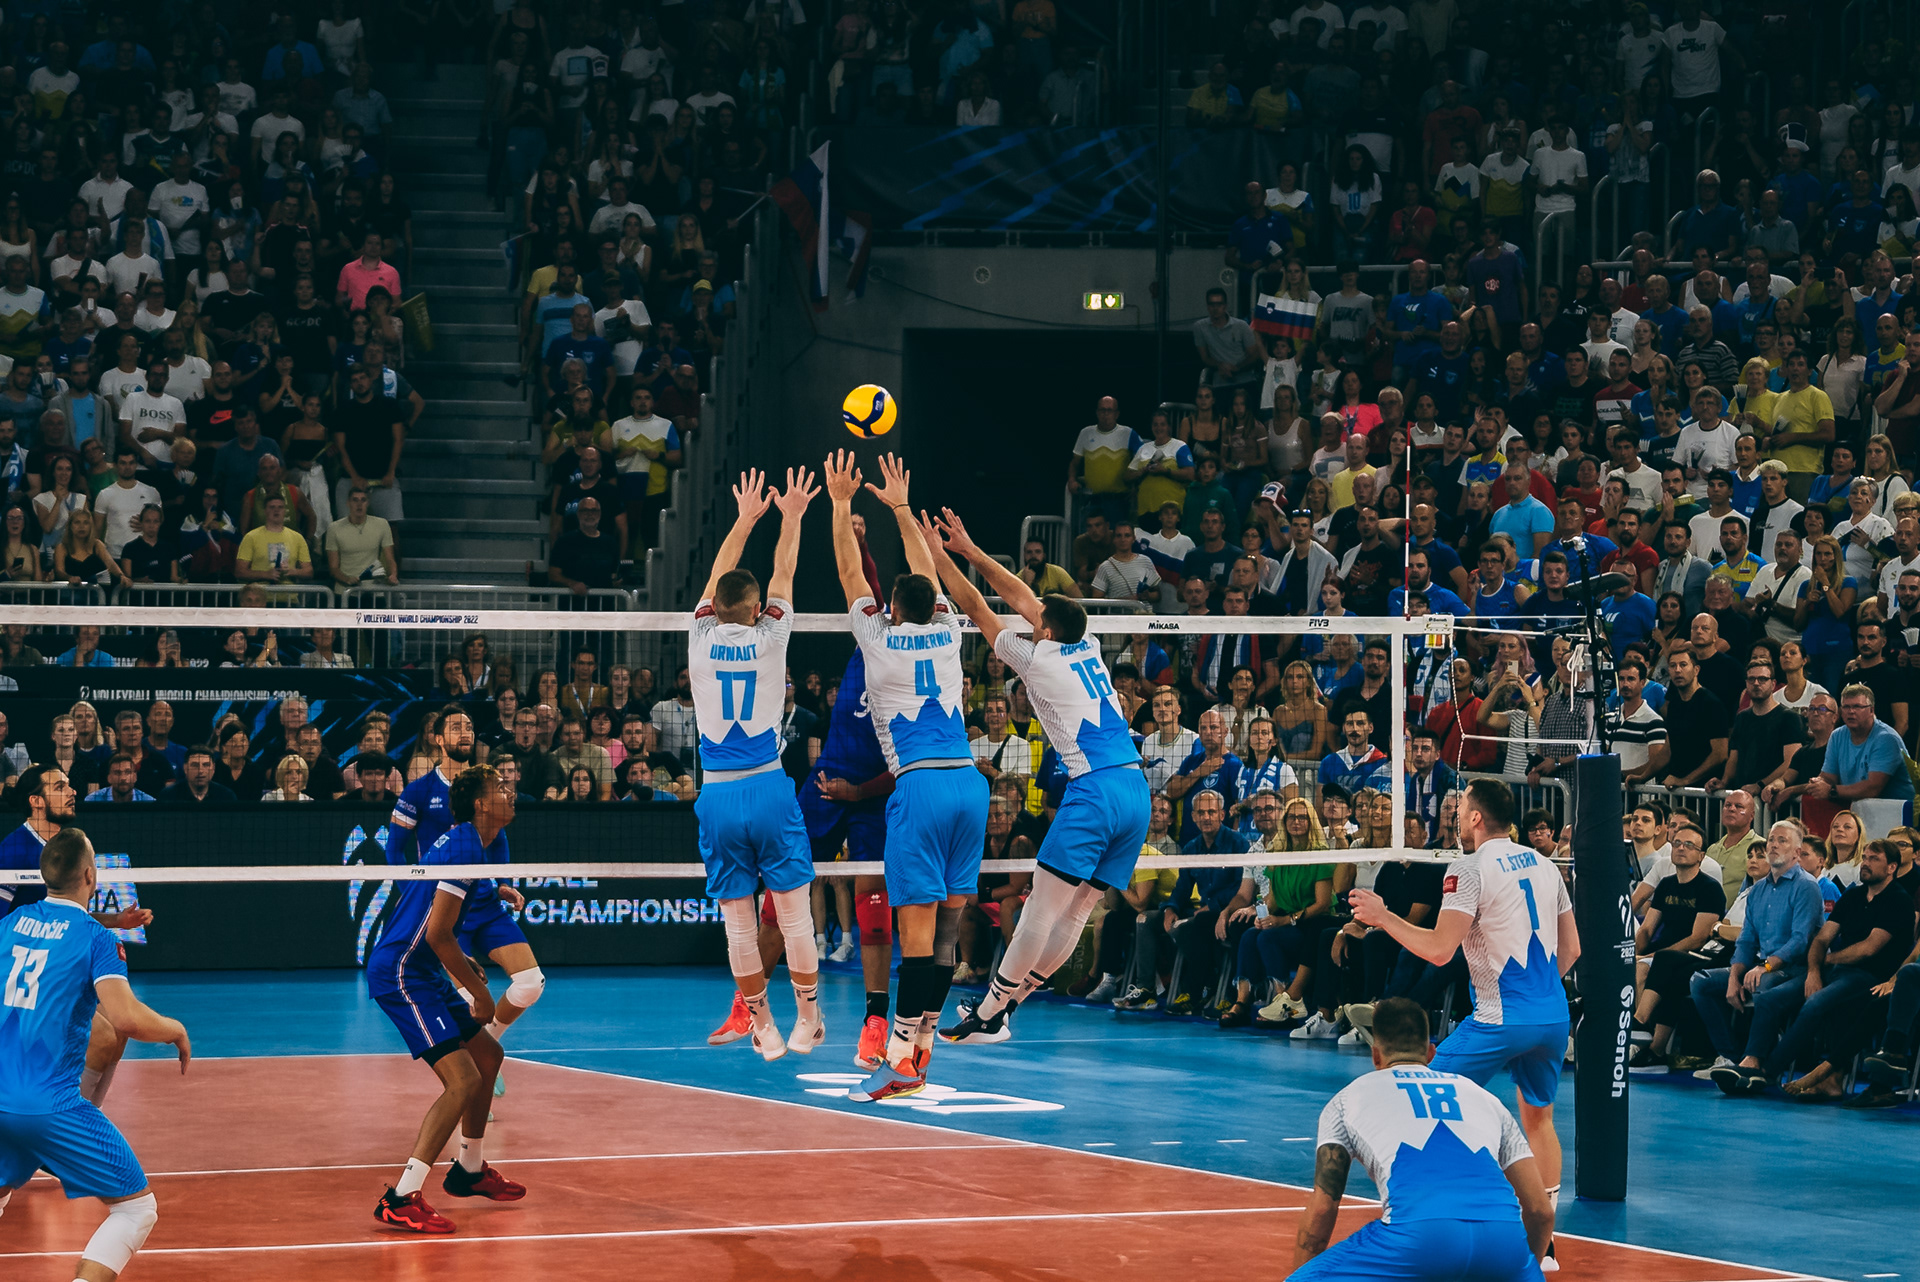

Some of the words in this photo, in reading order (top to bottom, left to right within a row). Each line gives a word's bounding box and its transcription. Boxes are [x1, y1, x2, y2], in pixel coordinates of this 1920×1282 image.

[140, 409, 174, 421] BOSS
[363, 614, 396, 624] VOLLEYBALL
[398, 614, 419, 624] WORLD
[420, 614, 462, 624] CHAMPIONSHIP
[463, 614, 479, 624] 2022
[1309, 619, 1330, 628] FIVB
[710, 643, 757, 661] URNAUT
[914, 659, 942, 698] 4
[1069, 657, 1113, 700] 16
[92, 688, 150, 700] VOLLEYBALL
[155, 688, 193, 700] WORLD
[715, 669, 757, 721] 17
[1496, 857, 1510, 873] T.
[1506, 851, 1539, 872] ŠTERN
[525, 899, 725, 923] CHAMPIONSH
[1518, 878, 1540, 930] 1
[3, 944, 50, 1010] 13
[436, 1016, 446, 1031] 1
[1611, 1010, 1632, 1098] Senoh
[1396, 1083, 1464, 1121] 18
